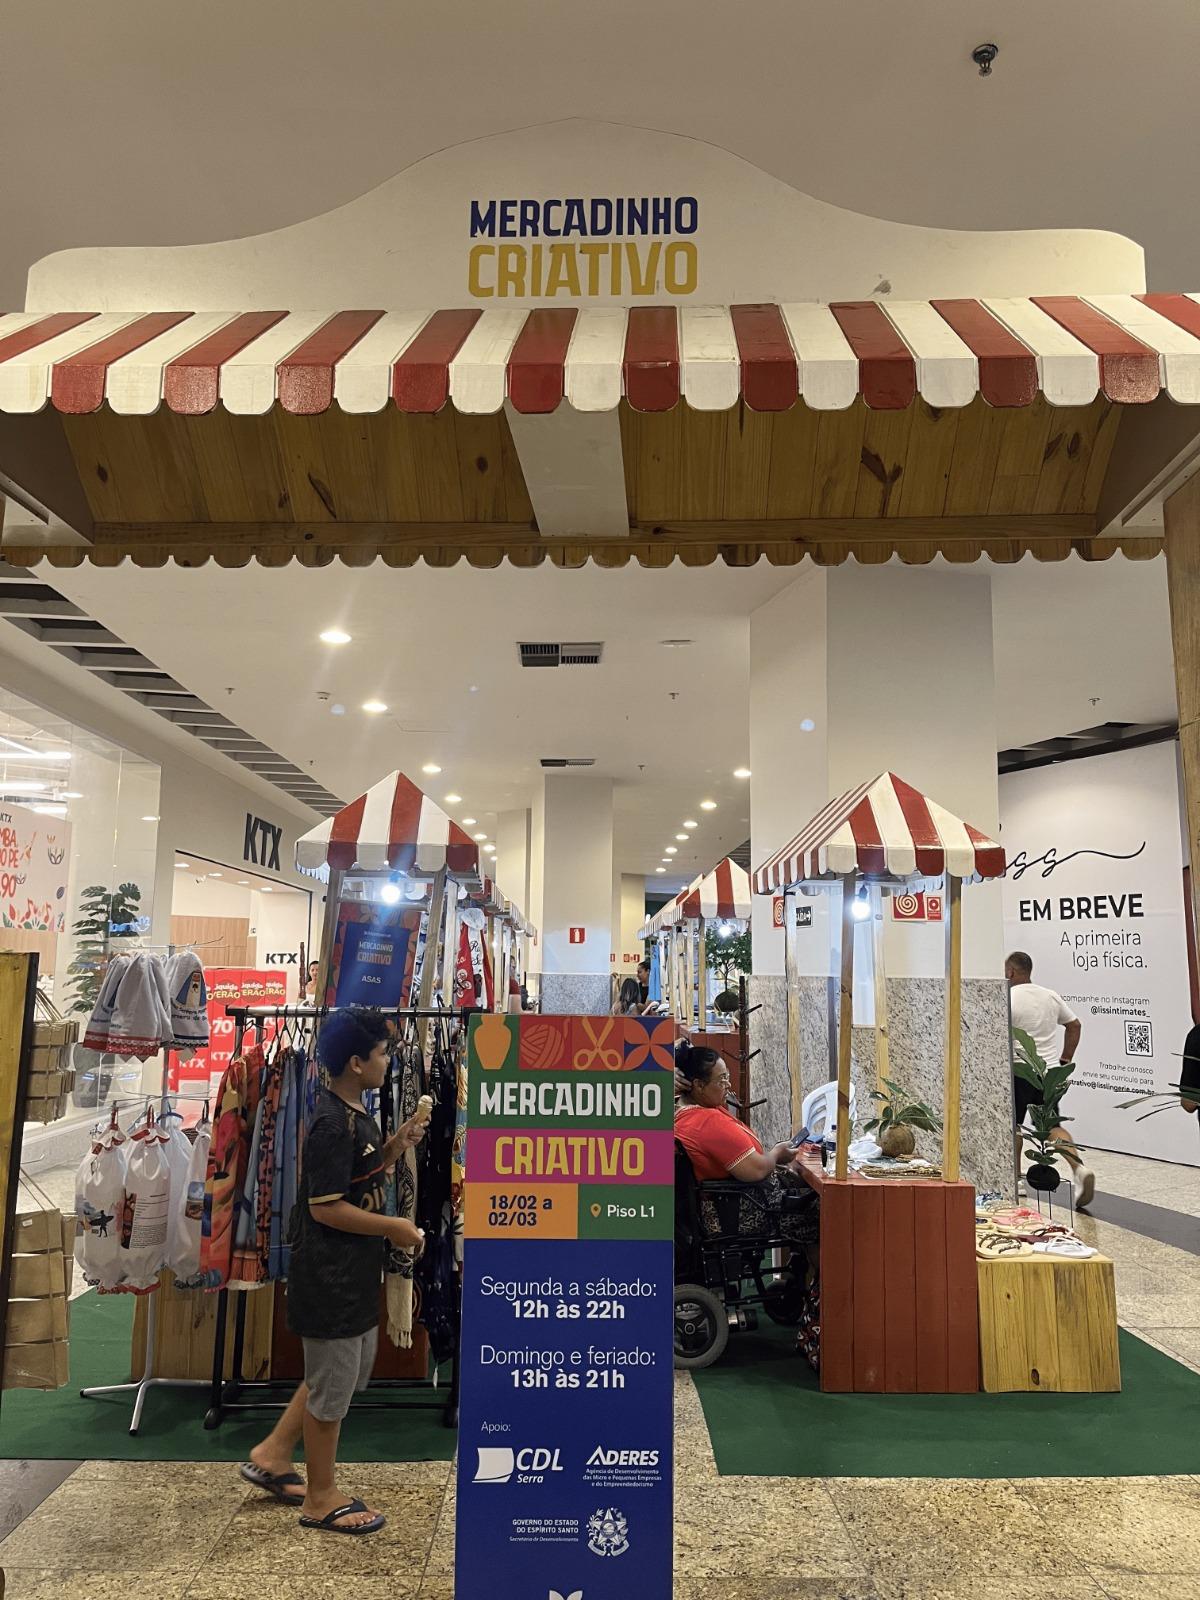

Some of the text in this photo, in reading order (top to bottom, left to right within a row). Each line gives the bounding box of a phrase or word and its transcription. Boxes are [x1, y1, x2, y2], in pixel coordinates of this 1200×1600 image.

[470, 196, 698, 238] MERCADINHO
[468, 241, 698, 298] CRIATIVO
[243, 812, 283, 871] KTX
[1019, 893, 1144, 921] EM BREVE
[1060, 928, 1141, 949] A primeira
[265, 953, 298, 964] KTX
[1072, 951, 1148, 971] loja física.
[1101, 995, 1111, 1003] no
[1091, 1005, 1151, 1018] @lissintimates_
[1099, 1061, 1127, 1072] Trabalhe
[479, 1081, 662, 1117] MERCADINHO
[495, 1136, 645, 1176] CRIATIVO
[489, 1195, 553, 1210] 18/02 a
[607, 1204, 655, 1218] Piso L1
[488, 1211, 537, 1226] 02/03
[480, 1275, 657, 1301] Segunda a sábado:
[512, 1299, 625, 1319] 12h às 22h
[480, 1344, 656, 1370] Domingo e feriado:
[510, 1368, 625, 1388] 13h às 21h
[481, 1421, 511, 1435] Apoio:
[516, 1447, 563, 1471] CDL
[586, 1445, 659, 1466] ADERES
[517, 1473, 543, 1483] Serra
